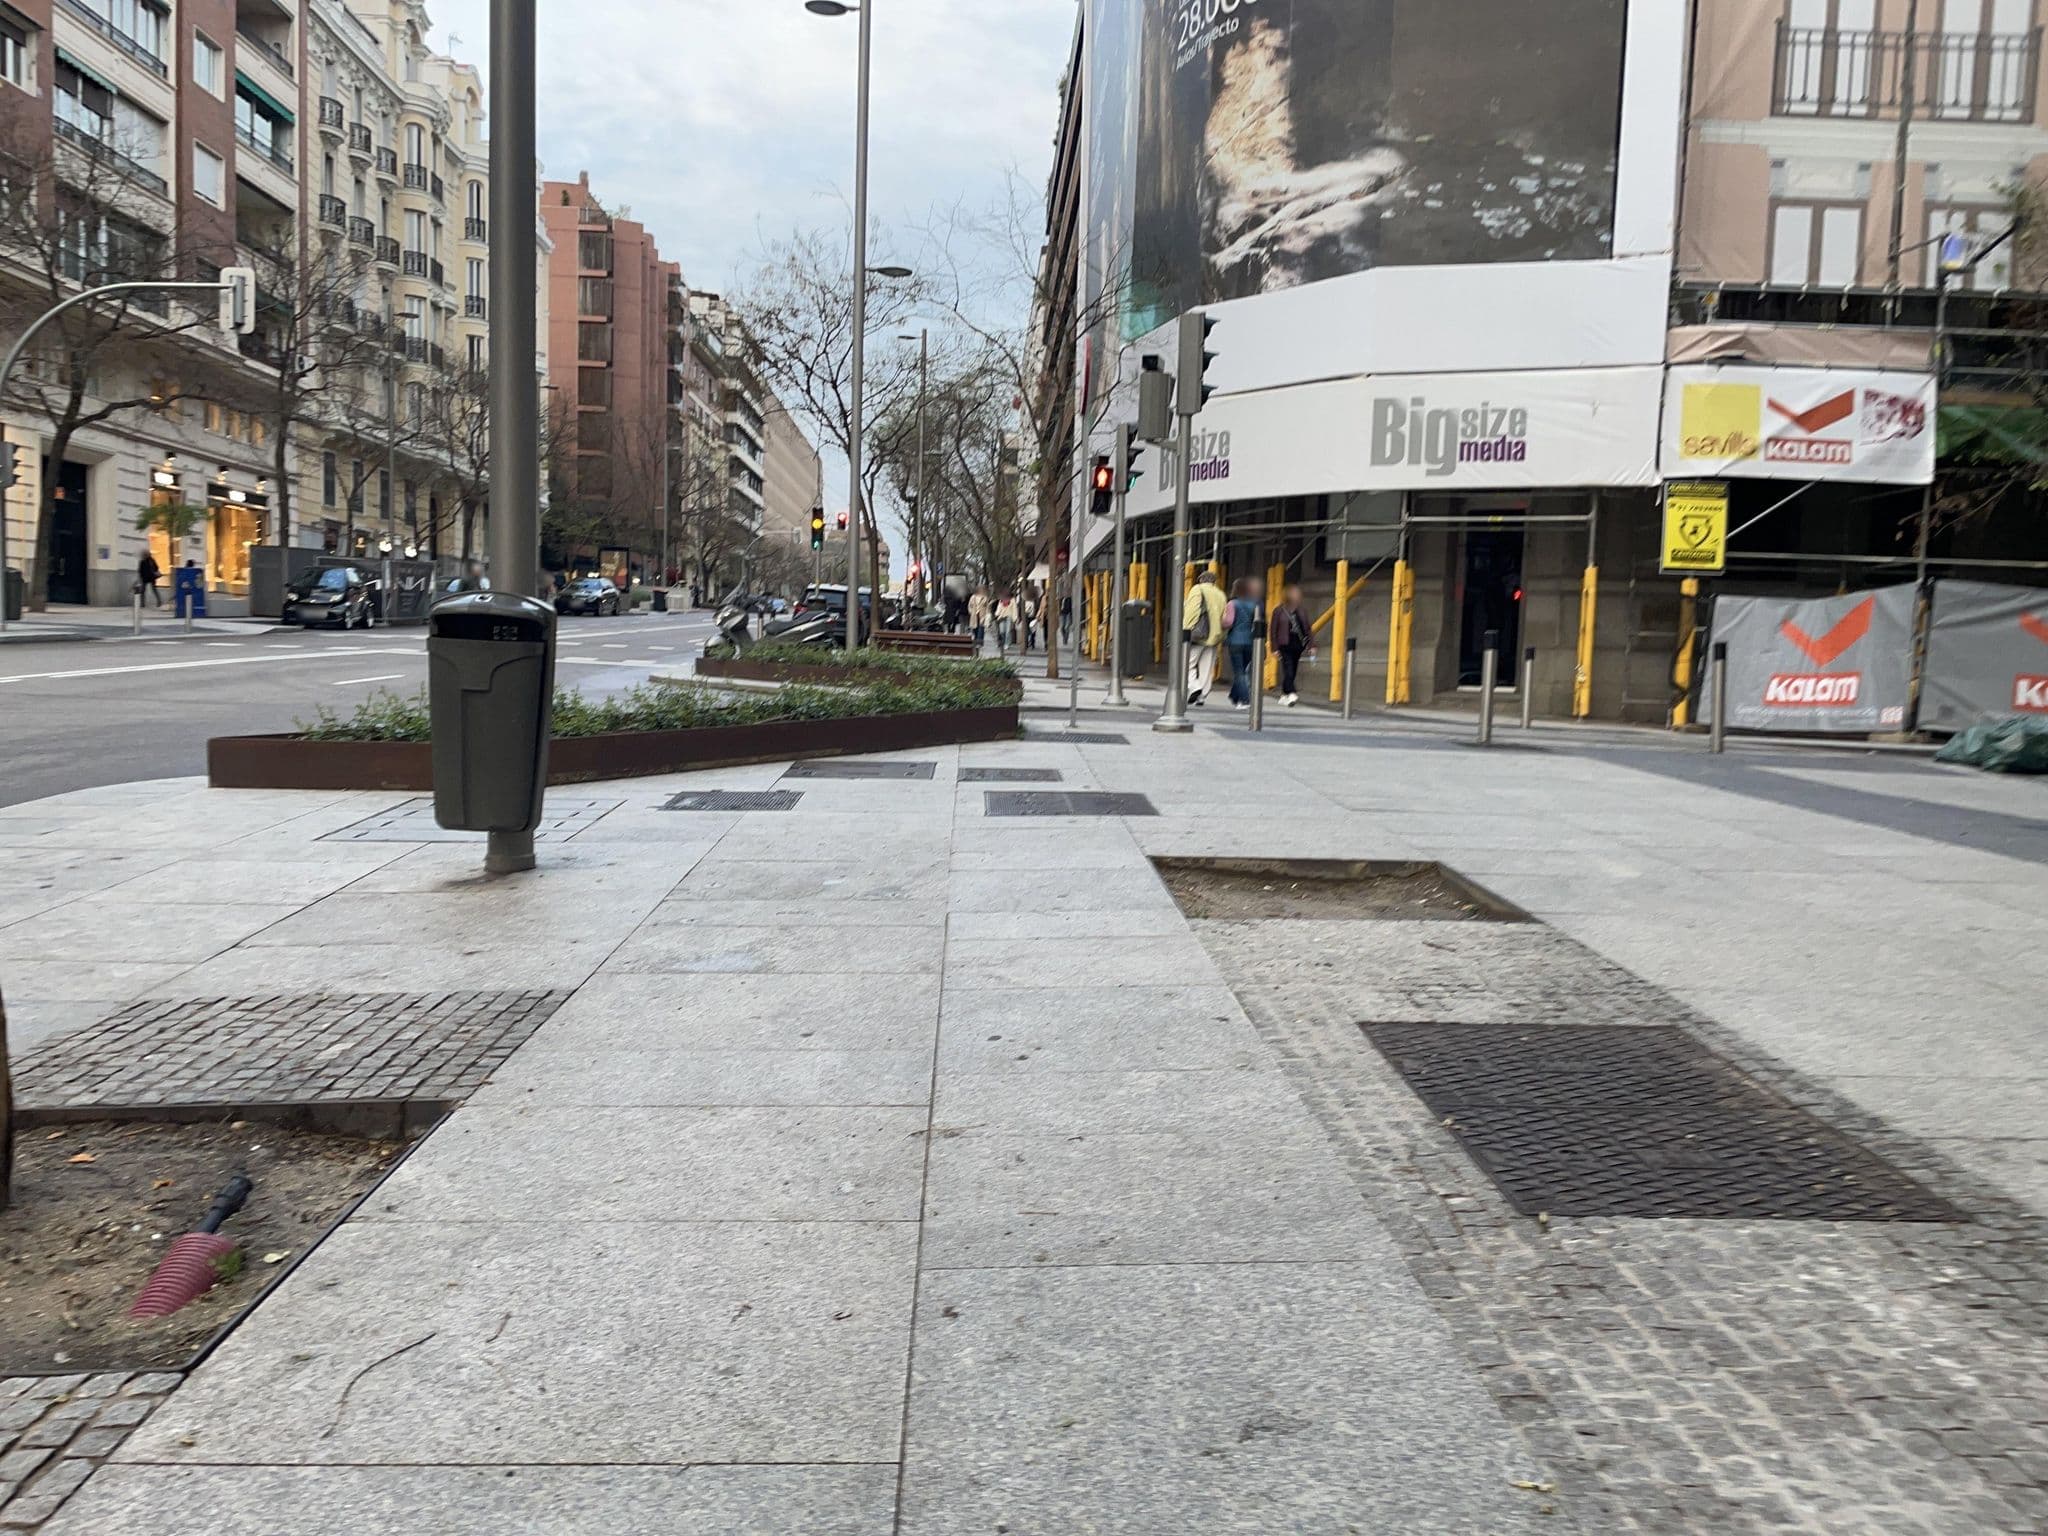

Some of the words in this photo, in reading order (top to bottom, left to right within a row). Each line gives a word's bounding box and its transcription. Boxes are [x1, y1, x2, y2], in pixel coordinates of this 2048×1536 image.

[1190, 428, 1230, 461] size
[1370, 397, 1459, 477] Big
[1460, 402, 1527, 438] size
[1459, 435, 1526, 462] media
[1189, 456, 1229, 481] media
